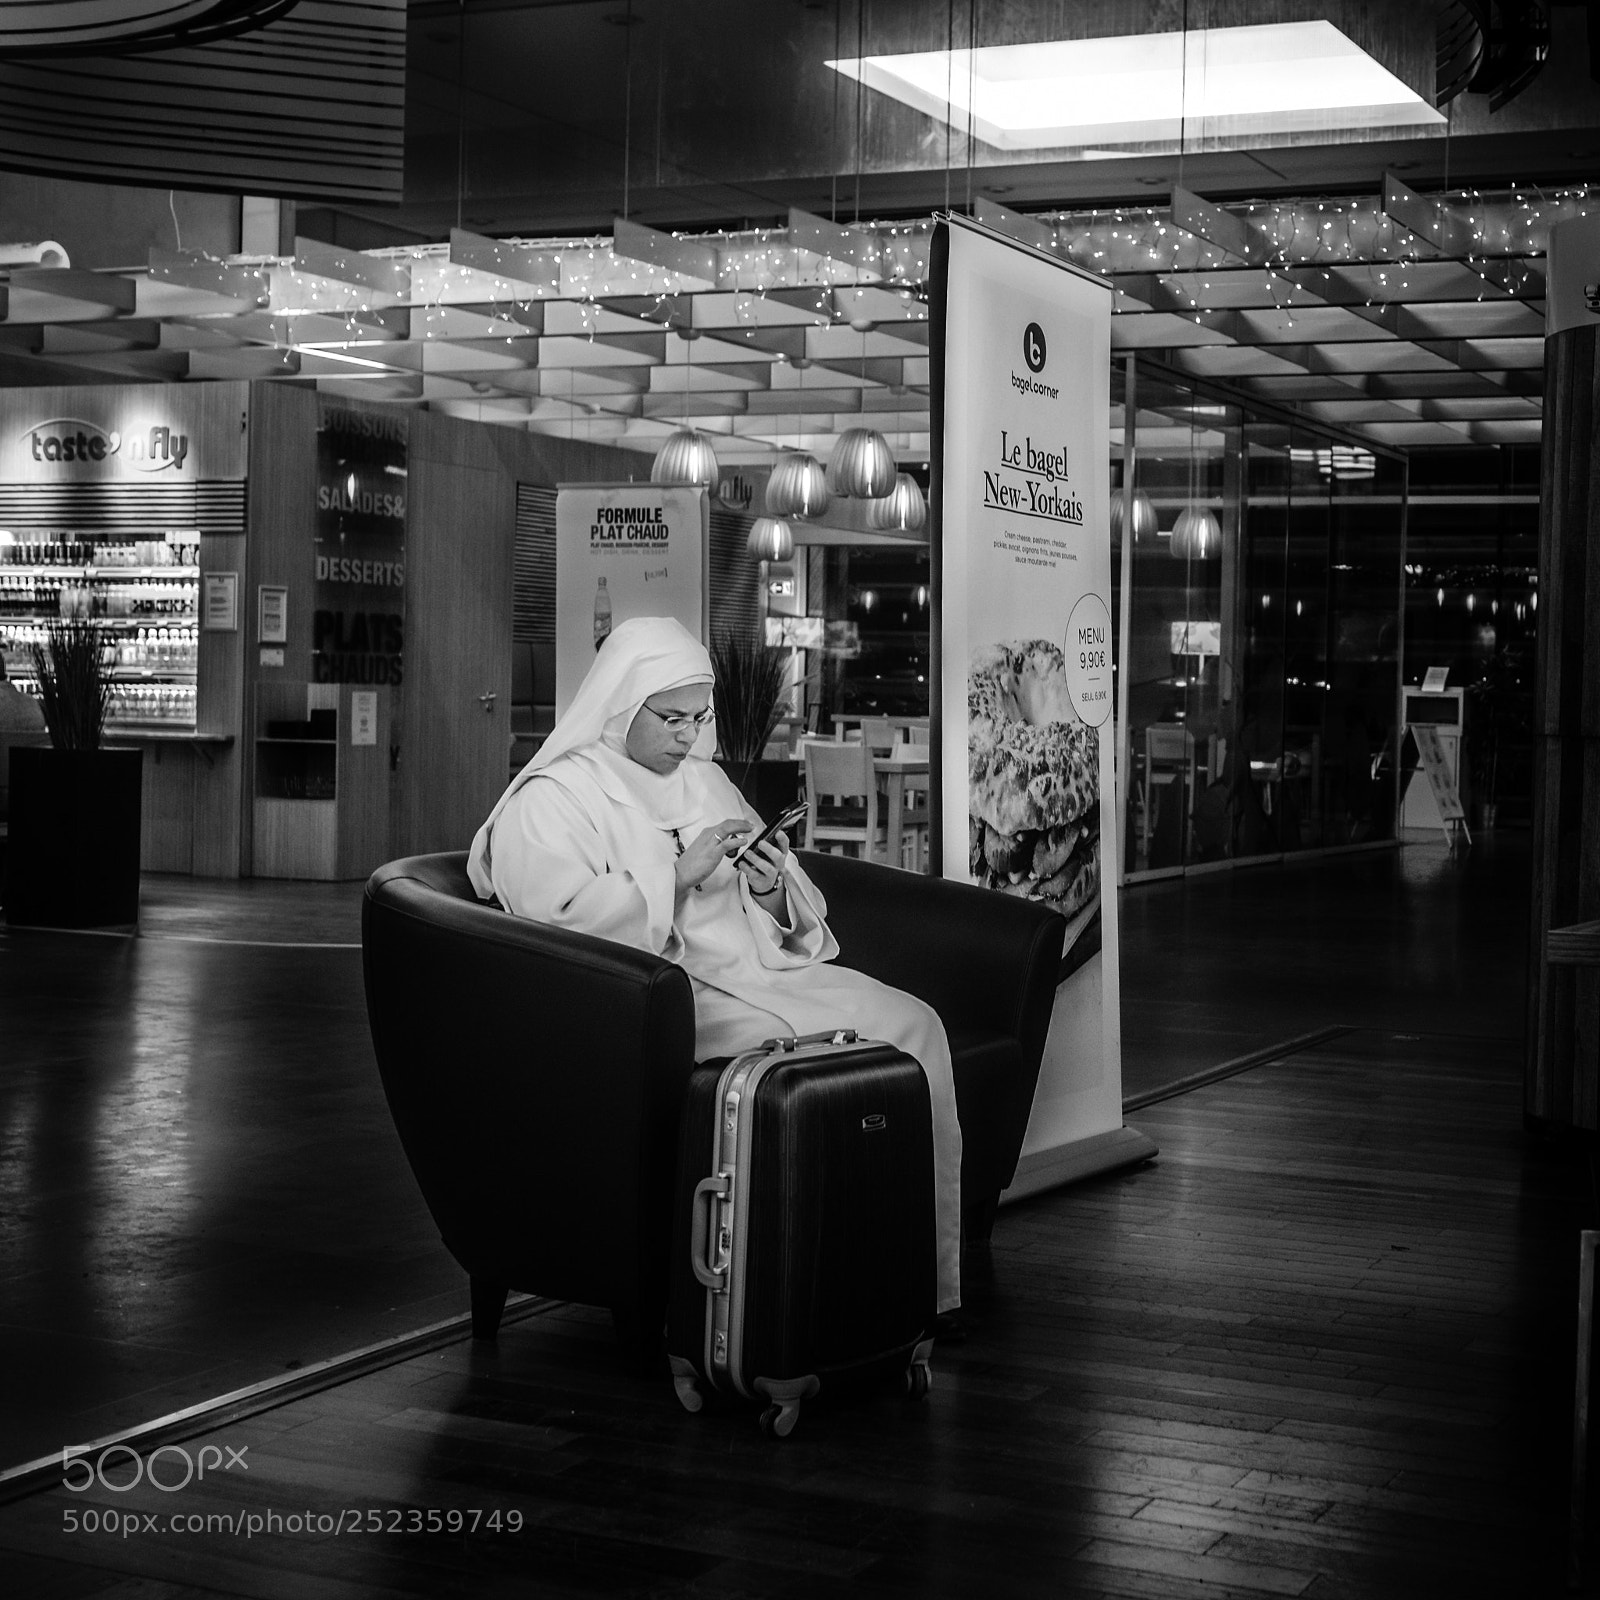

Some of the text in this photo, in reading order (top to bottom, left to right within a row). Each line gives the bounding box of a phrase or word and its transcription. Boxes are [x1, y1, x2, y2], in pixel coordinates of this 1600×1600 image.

[1001, 430, 1068, 482] Le bagel
[984, 470, 1083, 521] New-Yorkais
[597, 507, 663, 524] FORMULE
[590, 524, 669, 540] PLAT CHAUD
[316, 555, 404, 587] DESSERTS
[314, 610, 403, 653] PLATS
[1078, 627, 1105, 645] MENU
[313, 653, 403, 686] CHAUDS
[1080, 651, 1106, 671] 9,90€
